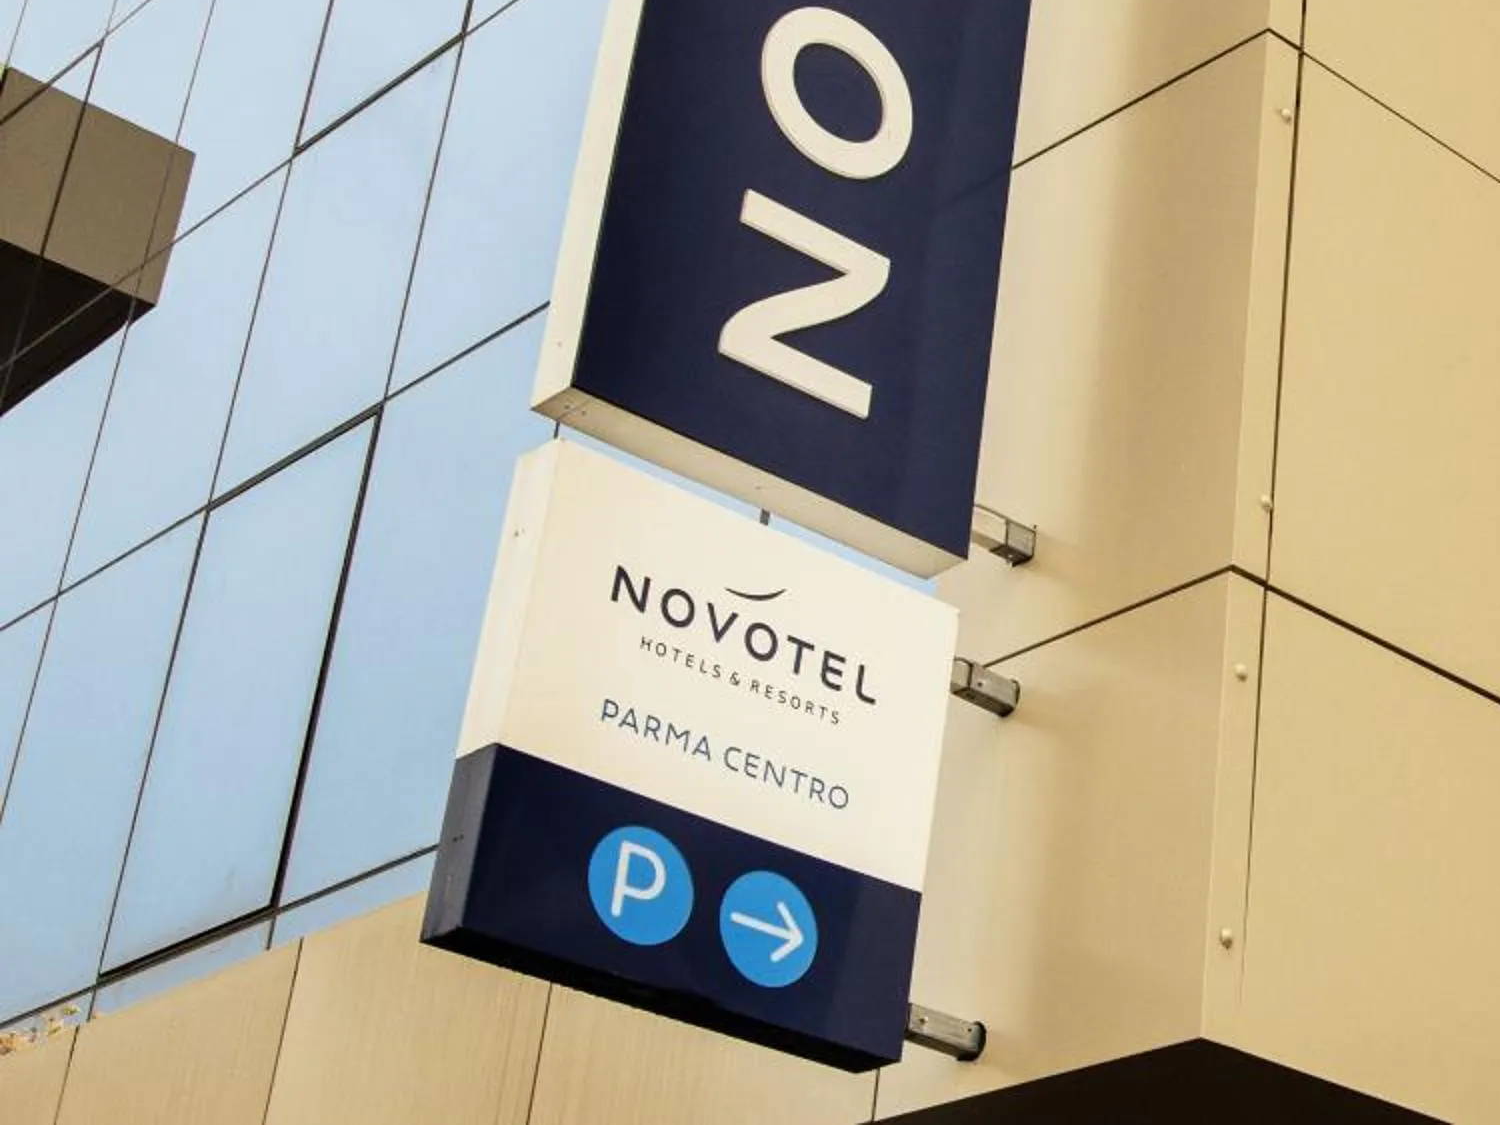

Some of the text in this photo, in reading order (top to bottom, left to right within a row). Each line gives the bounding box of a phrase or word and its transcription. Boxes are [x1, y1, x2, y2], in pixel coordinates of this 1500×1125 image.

[610, 565, 877, 705] NOVOTEL
[640, 636, 841, 725] HOTELS & RESORTS
[600, 698, 850, 811] PARMA CENTRO
[611, 840, 666, 917] P
